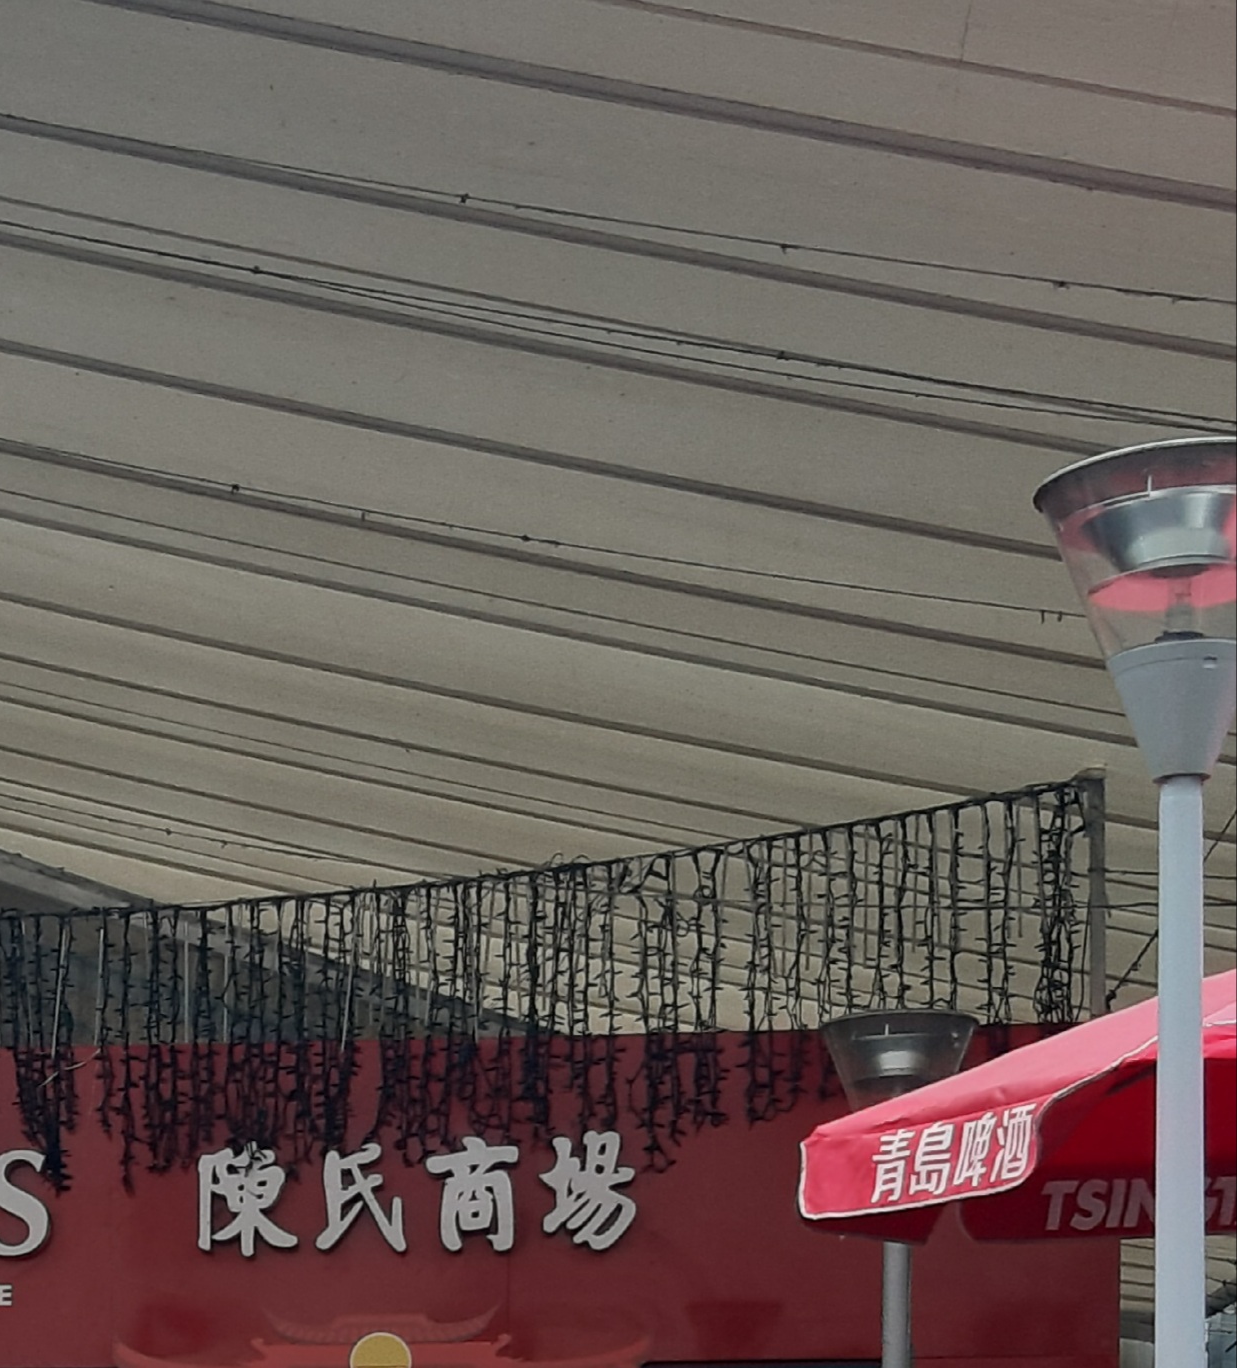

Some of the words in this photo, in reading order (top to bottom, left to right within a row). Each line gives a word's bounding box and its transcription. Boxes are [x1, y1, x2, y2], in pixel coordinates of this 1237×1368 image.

[197, 1131, 637, 1257] 陳氏商場
[871, 1102, 1038, 1204] 青島啤酒
